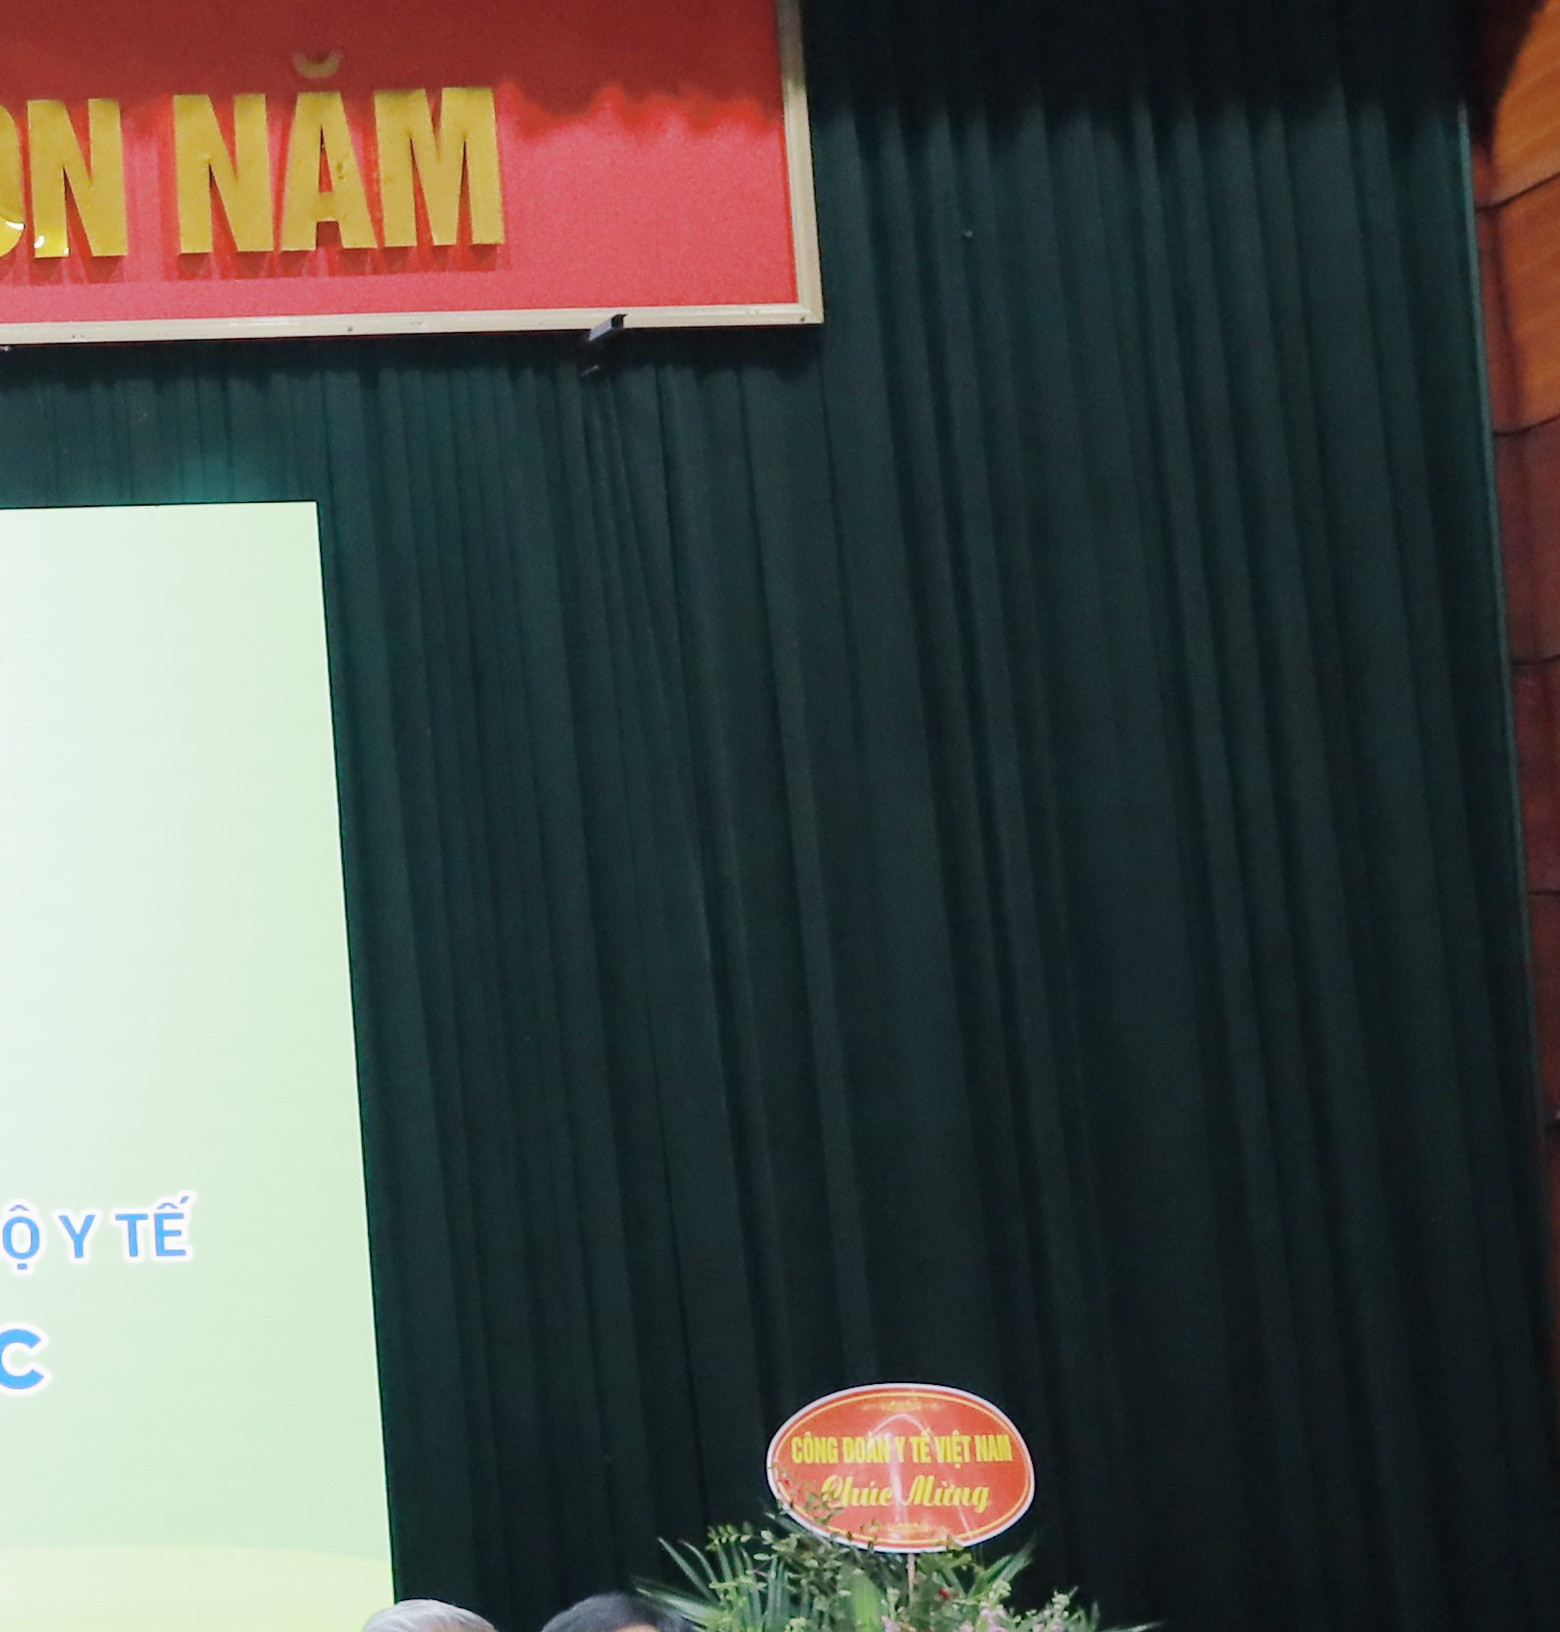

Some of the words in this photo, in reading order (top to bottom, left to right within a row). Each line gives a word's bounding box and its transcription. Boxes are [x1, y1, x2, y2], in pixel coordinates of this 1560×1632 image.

[173, 50, 504, 255] NĂM
[58, 1215, 95, 1258] Y
[115, 1194, 192, 1259] TẾ
[791, 1431, 838, 1464] CÔNG
[896, 1436, 906, 1463] Y
[934, 1430, 971, 1469] VIỆT
[975, 1434, 1013, 1462] NAM
